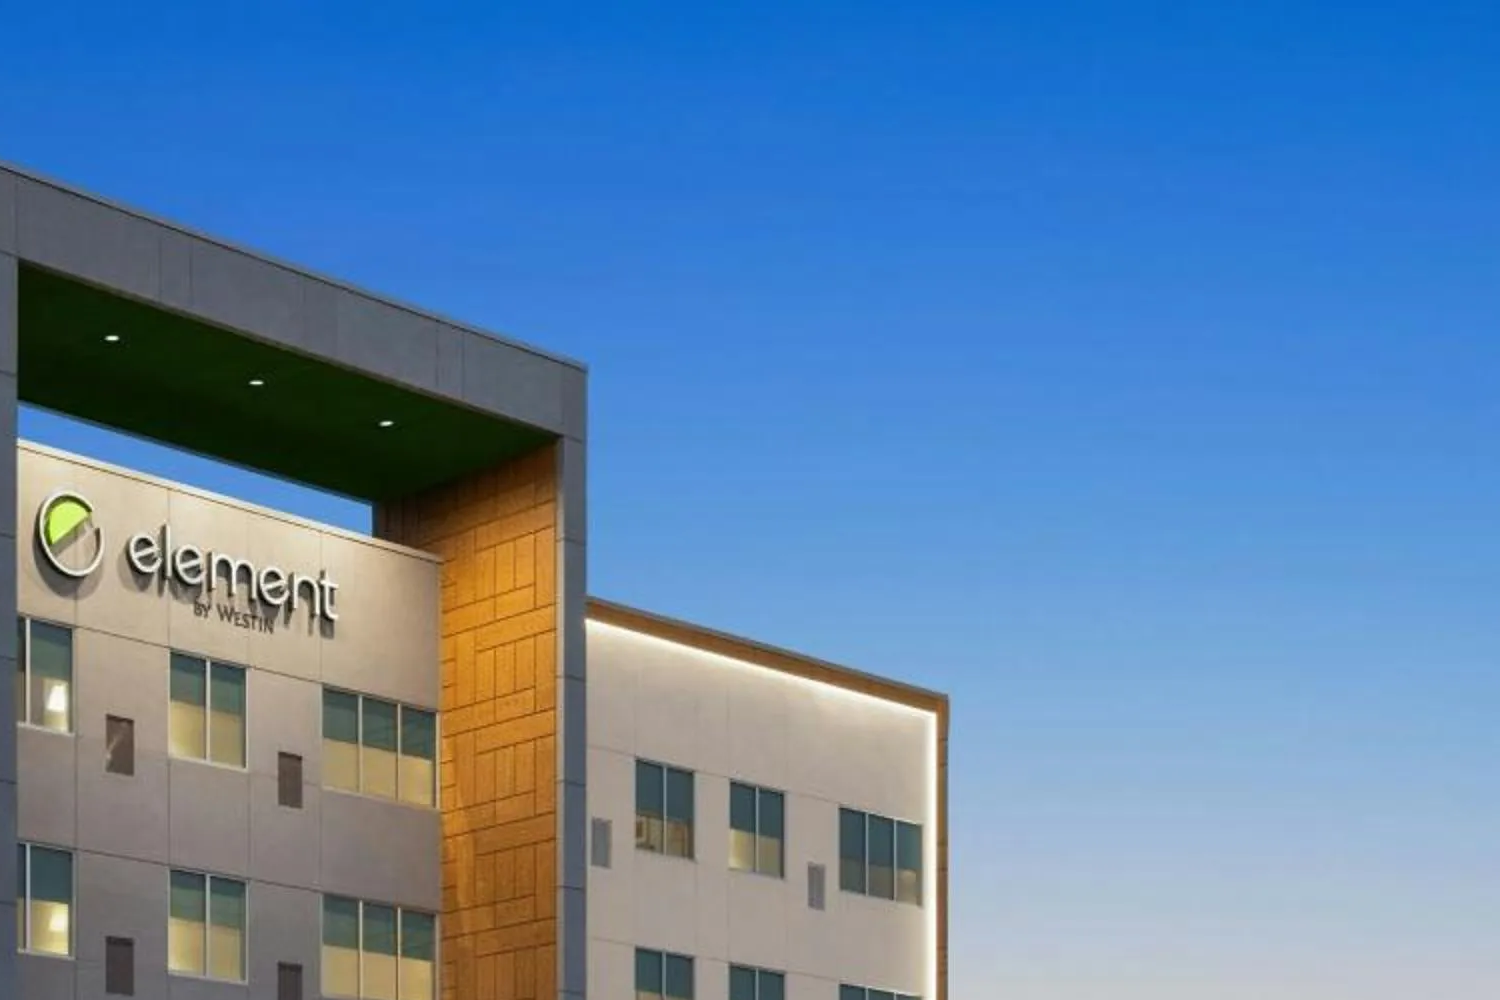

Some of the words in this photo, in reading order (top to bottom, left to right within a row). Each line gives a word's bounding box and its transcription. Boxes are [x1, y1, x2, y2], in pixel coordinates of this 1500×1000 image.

[129, 523, 339, 620] element
[194, 602, 211, 619] BY
[216, 603, 274, 634] WESTIN
